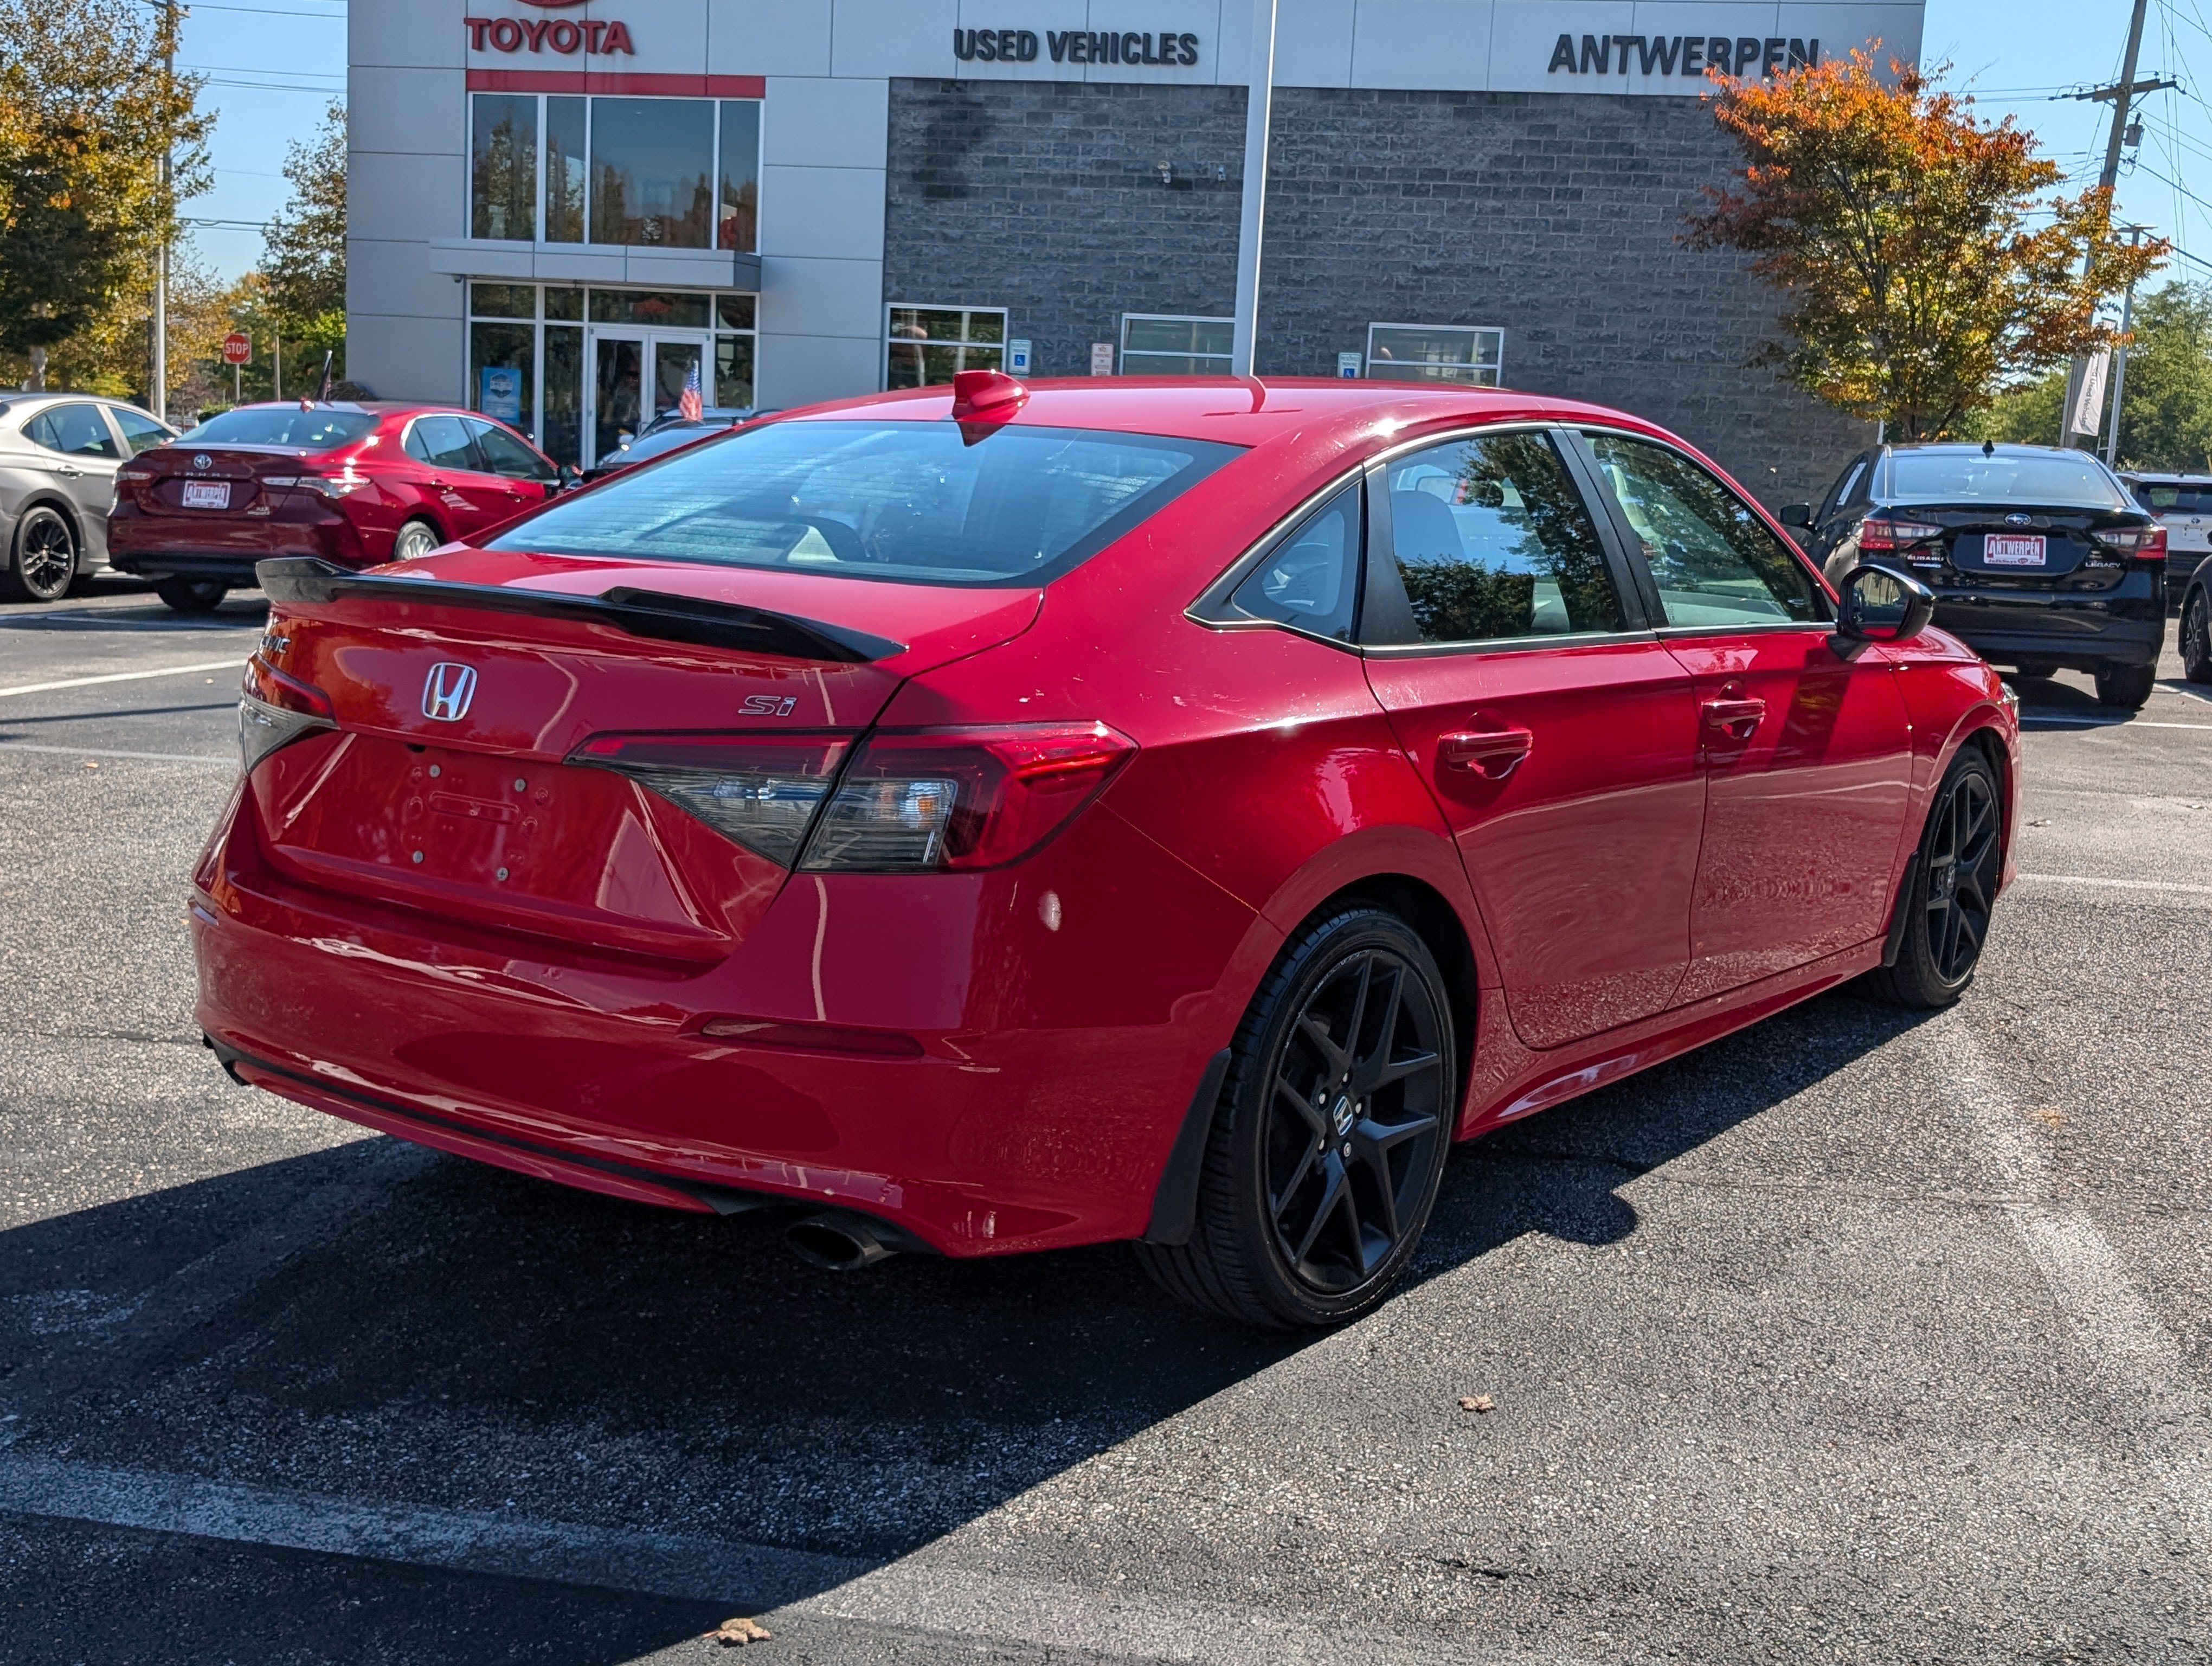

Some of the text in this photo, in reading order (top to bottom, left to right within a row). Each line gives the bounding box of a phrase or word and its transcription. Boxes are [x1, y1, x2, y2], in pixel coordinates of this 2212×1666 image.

[464, 17, 635, 55] TOYOTA
[954, 29, 1198, 66] USED VEHICLES
[1547, 34, 1819, 78] ANTWERPEN
[226, 342, 249, 355] STOP
[2086, 379, 2095, 398] Used
[1988, 540, 2040, 556] ANTWERPEN
[738, 695, 798, 716] Si
